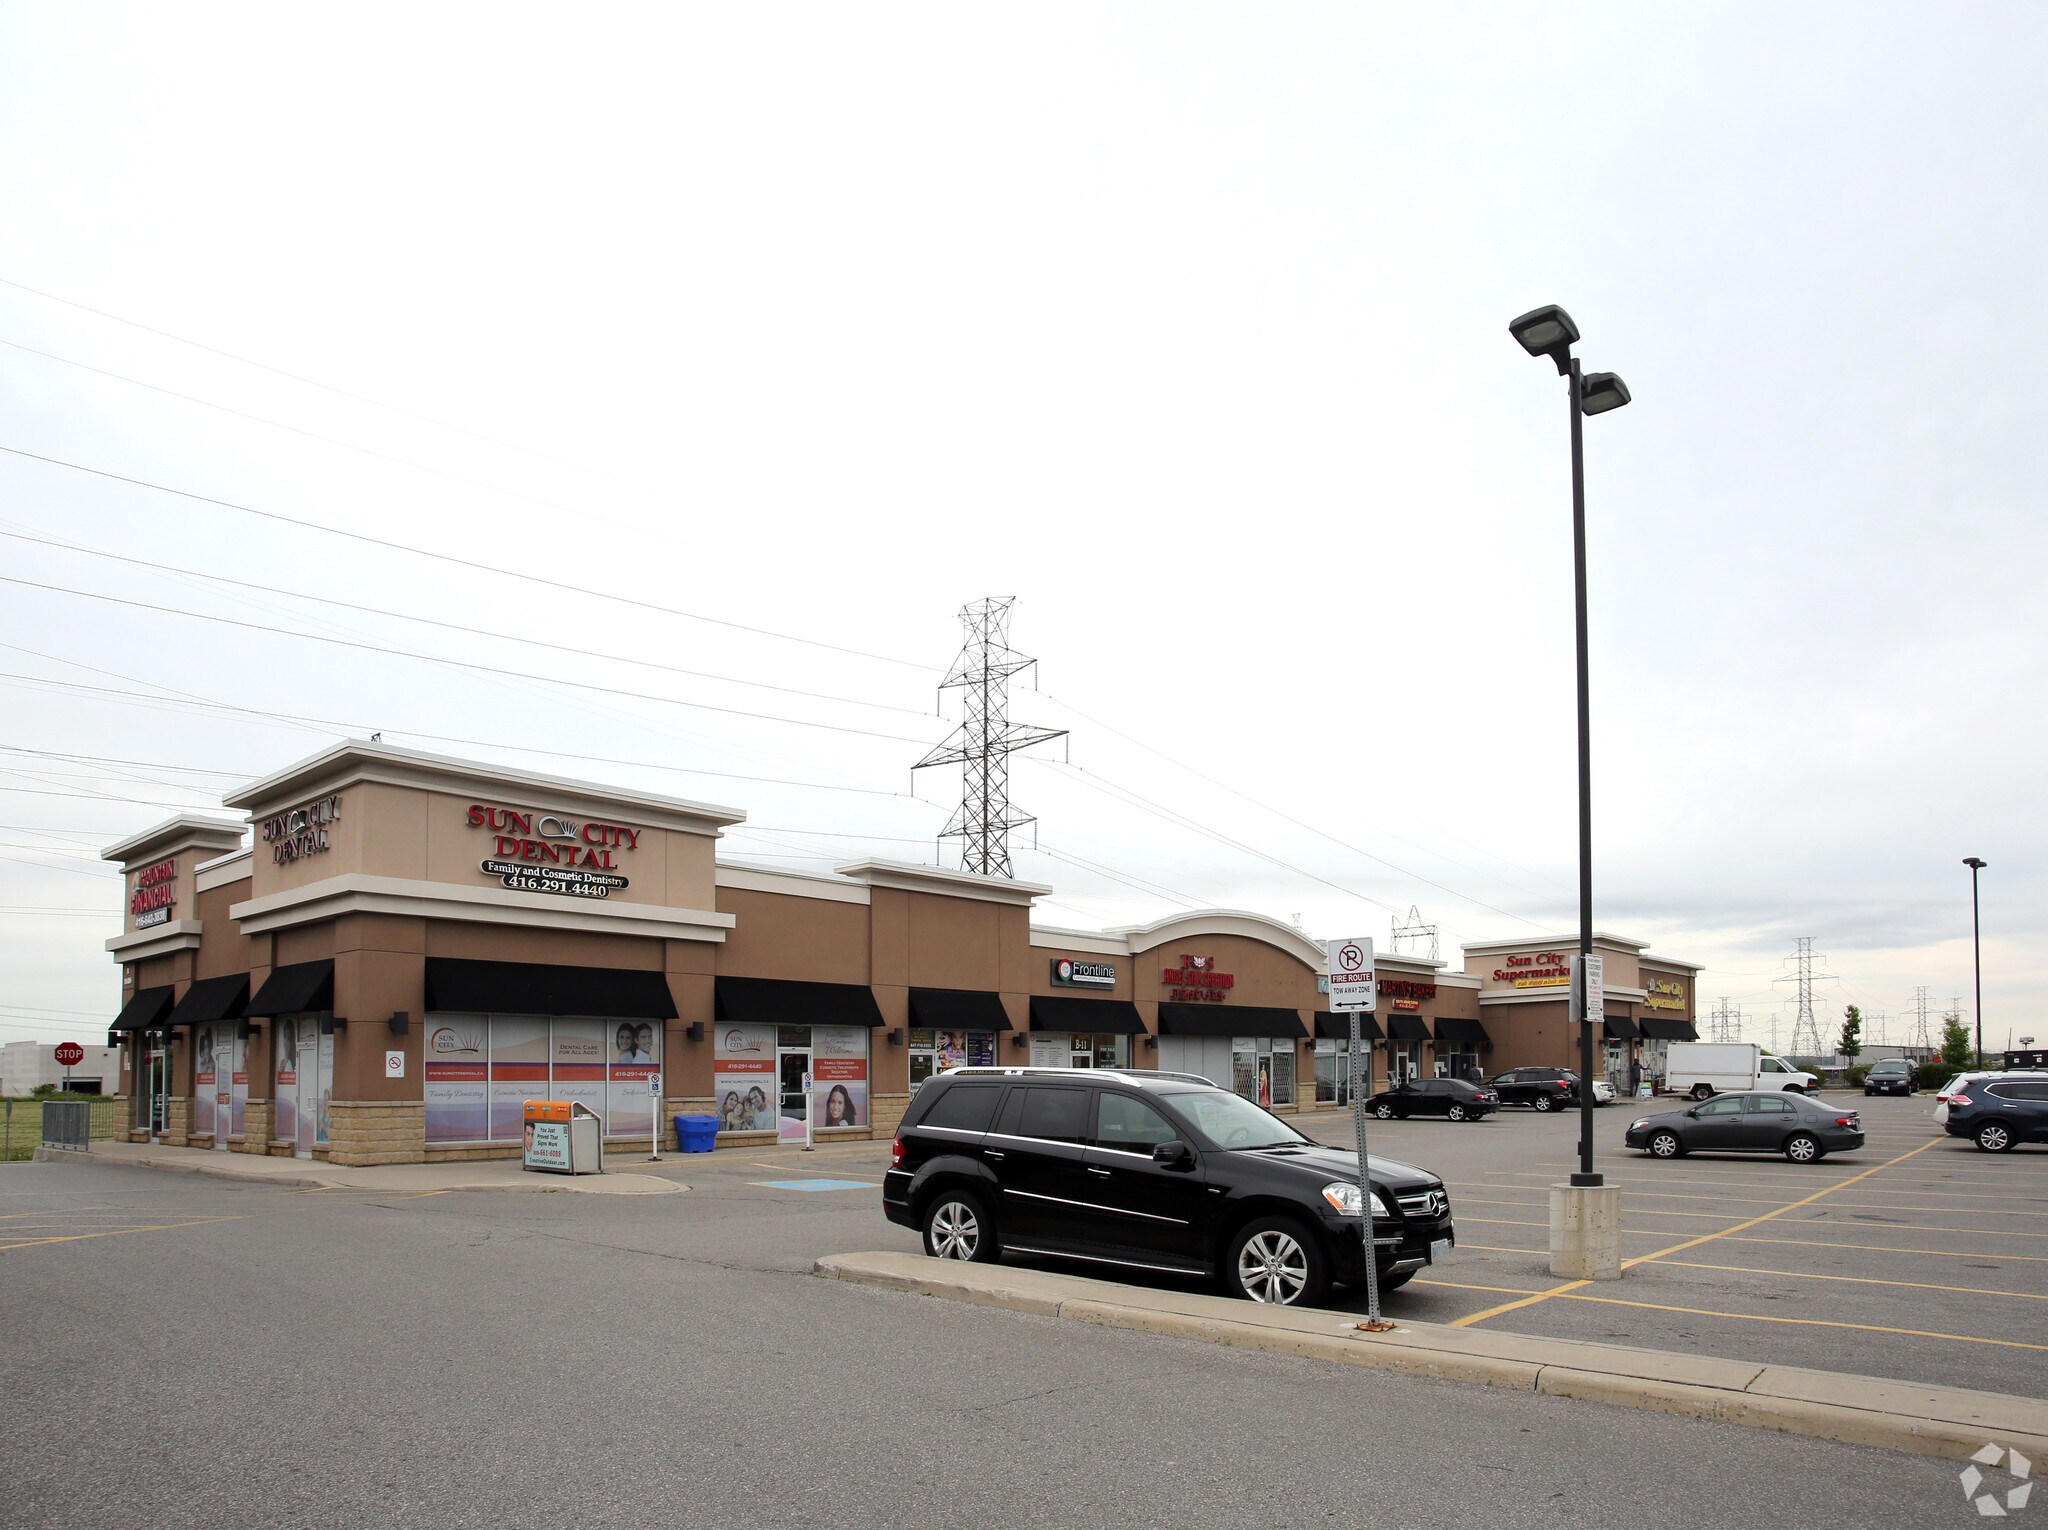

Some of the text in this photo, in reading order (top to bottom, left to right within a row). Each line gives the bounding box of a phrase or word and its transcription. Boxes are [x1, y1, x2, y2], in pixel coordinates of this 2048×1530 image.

[263, 795, 342, 841] SUN CITY
[467, 804, 641, 849] SUN CITY
[273, 829, 330, 864] DENTAL
[493, 835, 618, 870] DENTAL
[488, 861, 624, 887] Family and Cosmetic Dentistry
[508, 876, 607, 897] 416.291.4440
[131, 883, 174, 915] FINANCIAL
[1506, 952, 1564, 967] Sun City
[1073, 962, 1115, 977] Frontline
[1332, 973, 1371, 982] FIRE ROUTE
[1344, 986, 1358, 994] AWAY
[1656, 980, 1670, 993] Sun
[1075, 1039, 1087, 1049] B-11
[57, 1049, 82, 1059] STOP
[429, 1090, 484, 1098] Family Dentistry
